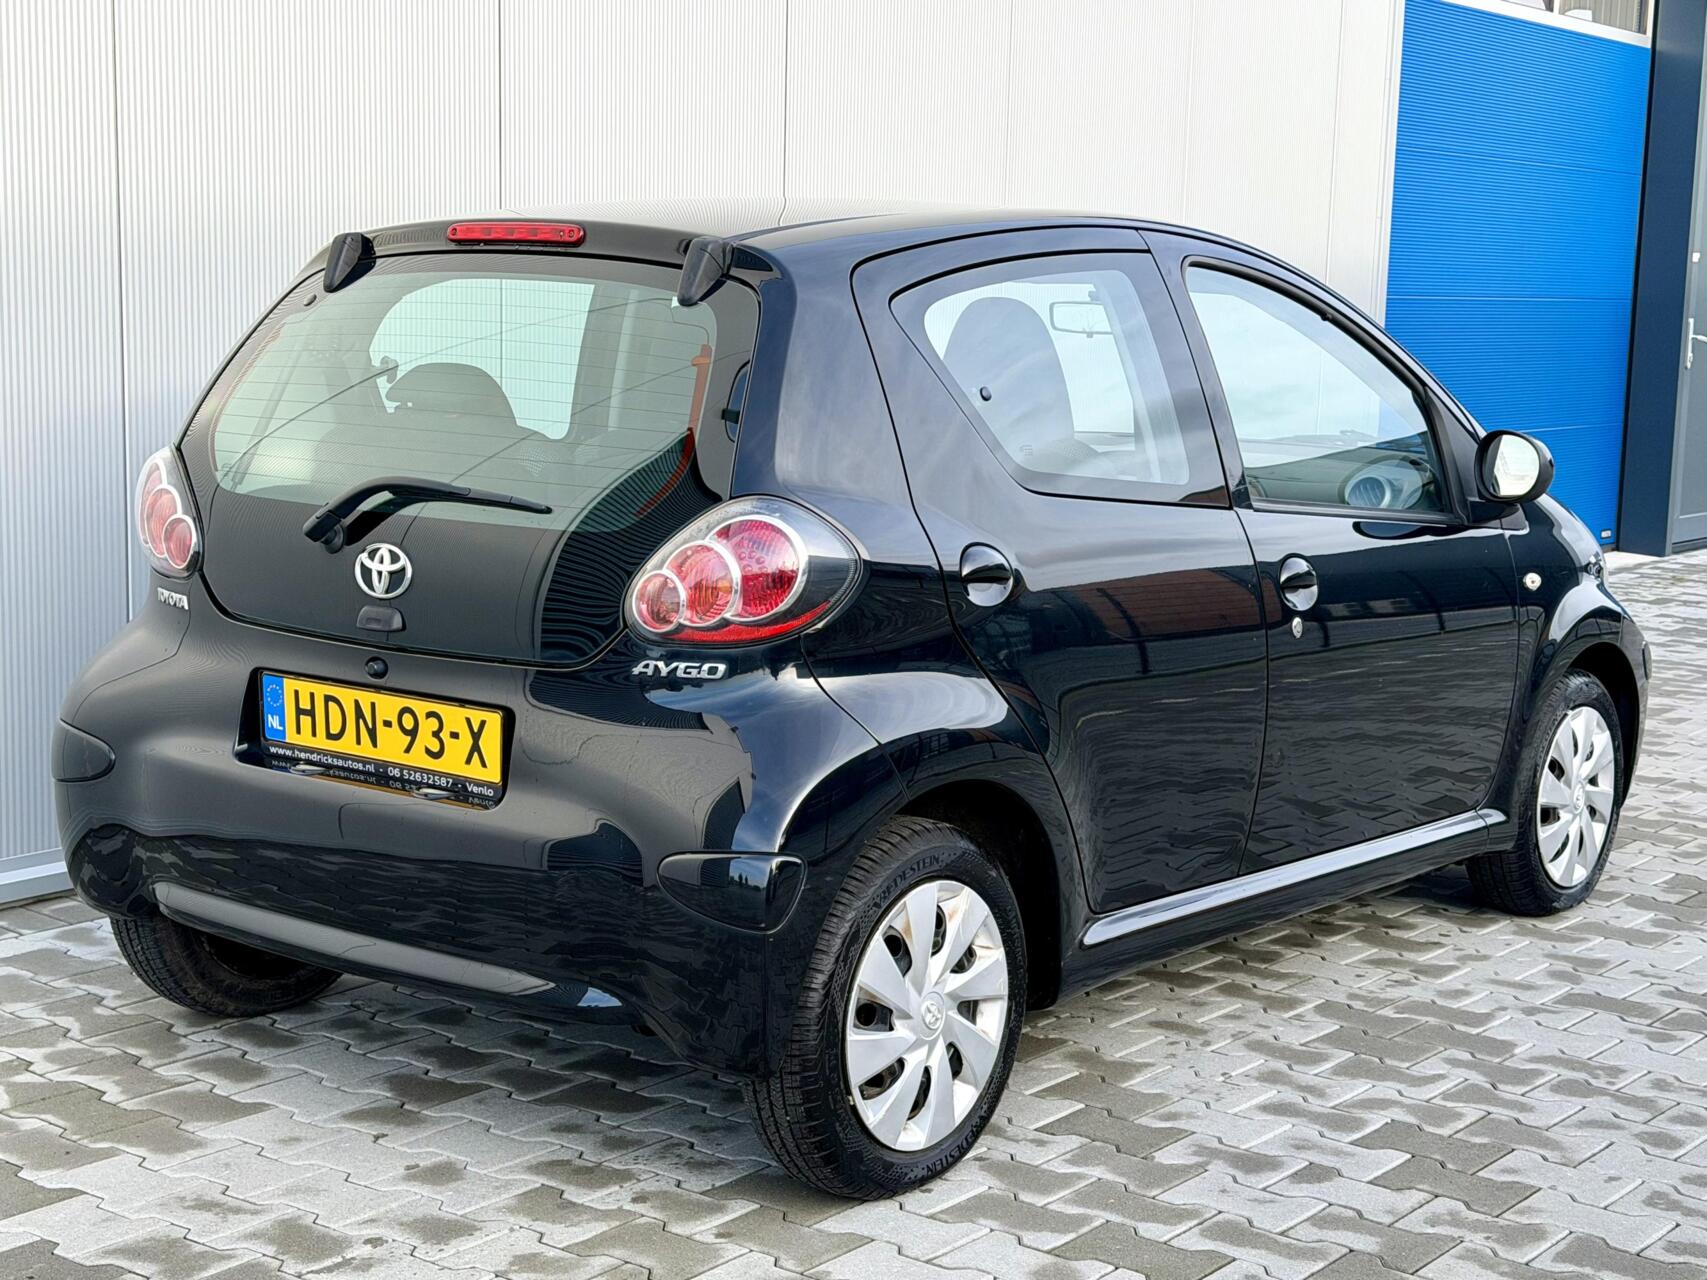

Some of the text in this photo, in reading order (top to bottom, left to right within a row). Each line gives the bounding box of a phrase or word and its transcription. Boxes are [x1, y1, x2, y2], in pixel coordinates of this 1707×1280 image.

[157, 586, 189, 610] TOYOTA
[631, 659, 727, 680] AYGO
[267, 714, 284, 731] NL
[293, 689, 488, 769] HDN-93-X
[269, 745, 375, 773] www.hendricksautos.nl
[387, 767, 400, 777] 06
[403, 769, 453, 788] 52632587
[466, 782, 494, 797] Venlo
[872, 854, 941, 909] VREDESTEIN
